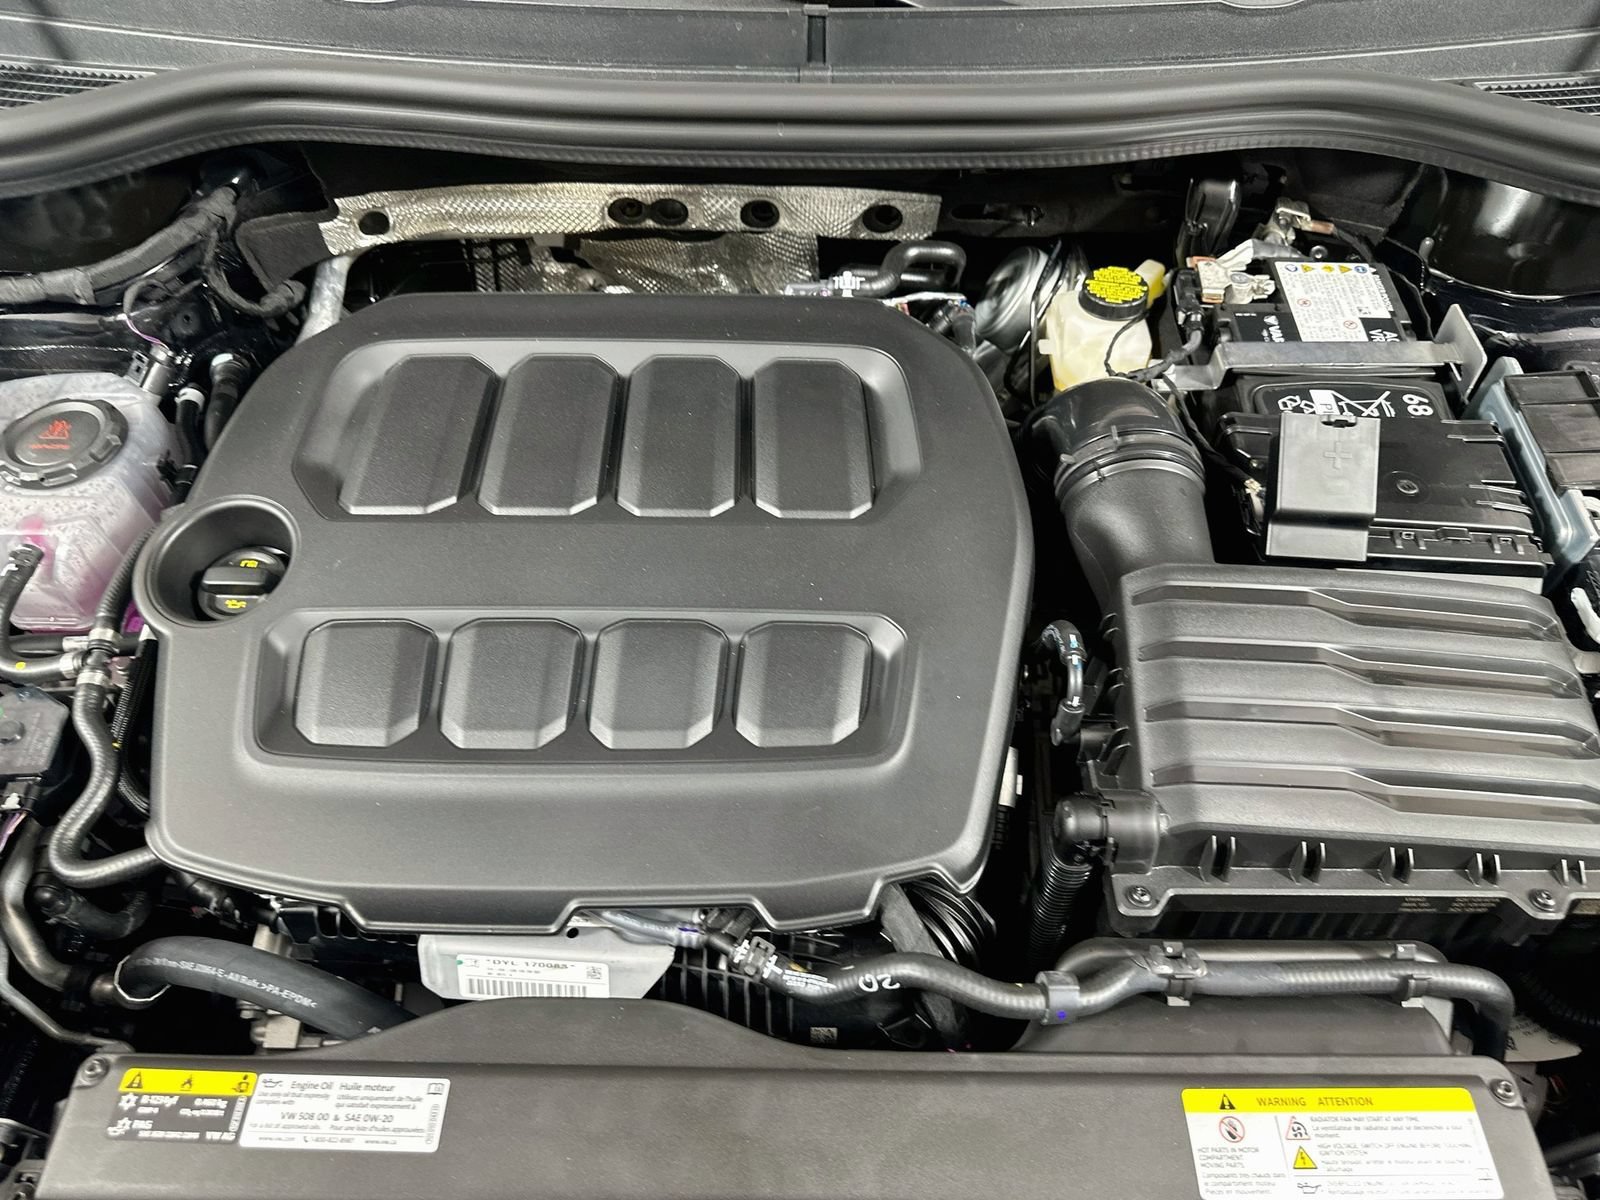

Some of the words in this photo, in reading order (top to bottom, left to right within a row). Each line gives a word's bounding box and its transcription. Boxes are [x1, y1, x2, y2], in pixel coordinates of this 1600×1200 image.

[1402, 393, 1433, 418] 68
[290, 1080, 319, 1091] Engine
[320, 1081, 334, 1090] Oil
[339, 1082, 362, 1091] Huile
[363, 1083, 396, 1092] moteur
[1256, 1096, 1307, 1107] WARNING
[1317, 1096, 1375, 1107] ATTENTION
[280, 1111, 297, 1120] VW
[344, 1113, 362, 1122] SAE
[362, 1114, 394, 1123] 0W-20
